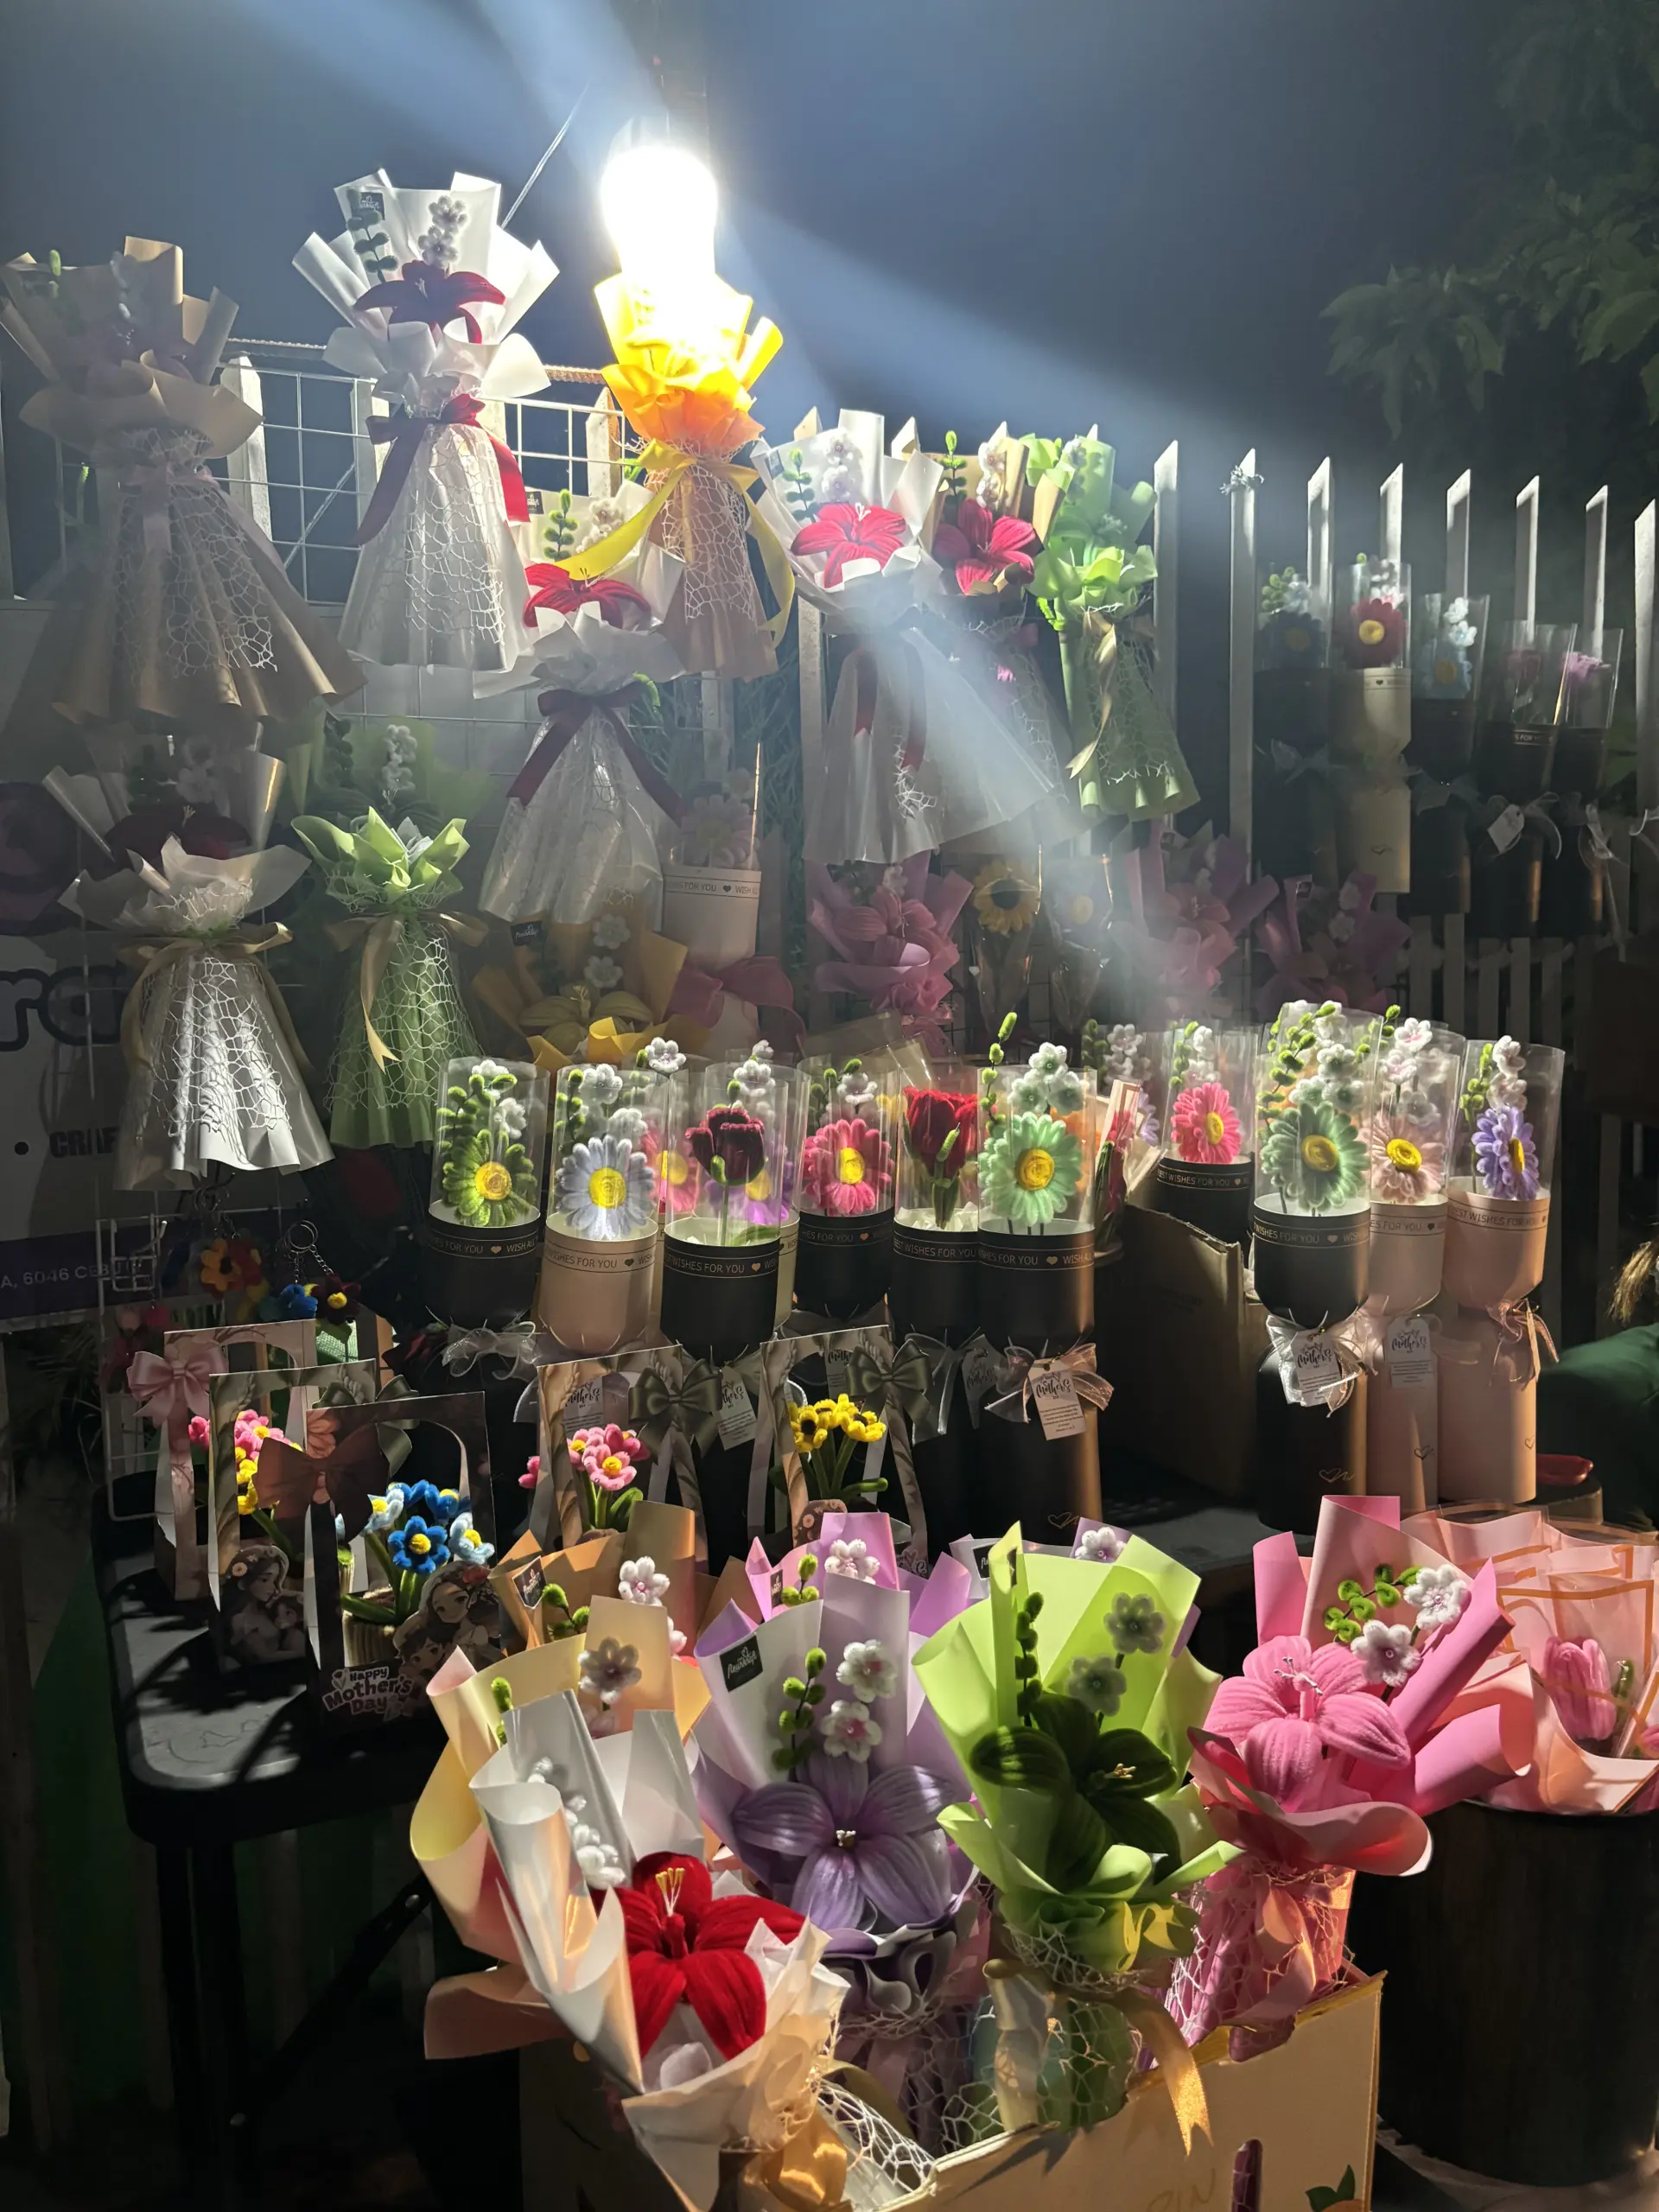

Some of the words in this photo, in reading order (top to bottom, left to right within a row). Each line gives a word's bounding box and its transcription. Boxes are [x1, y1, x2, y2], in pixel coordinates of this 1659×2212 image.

[684, 881, 698, 891] FOR
[701, 883, 716, 892] YOU
[1167, 1173, 1196, 1185] WISHES
[1198, 1178, 1213, 1187] FOR
[1215, 1178, 1230, 1187] YOU
[1468, 1210, 1505, 1226] WISHES
[1383, 1220, 1401, 1231] FOR
[1404, 1222, 1422, 1232] YOU
[817, 1231, 833, 1242] FOR
[836, 1233, 854, 1243] YOU
[1280, 1232, 1298, 1243] FOR
[1300, 1234, 1319, 1245] YOU
[445, 1241, 461, 1253] FOR
[464, 1244, 484, 1255] YOU
[506, 1241, 526, 1253] WISH
[905, 1243, 936, 1257] WISHES
[938, 1249, 956, 1258] FOR
[957, 1249, 976, 1258] YOU
[577, 1257, 595, 1268] FOR
[597, 1259, 618, 1269] YOU
[672, 1255, 702, 1272] WISHES
[704, 1262, 722, 1274] FOR
[725, 1264, 745, 1274] YOU
[998, 1253, 1015, 1266] FOR
[1018, 1255, 1039, 1266] YOU
[22, 1267, 70, 1286] 6046
[350, 1668, 388, 1681] Happy
[325, 1675, 412, 1710] Mother's
[352, 1696, 388, 1714] Day
